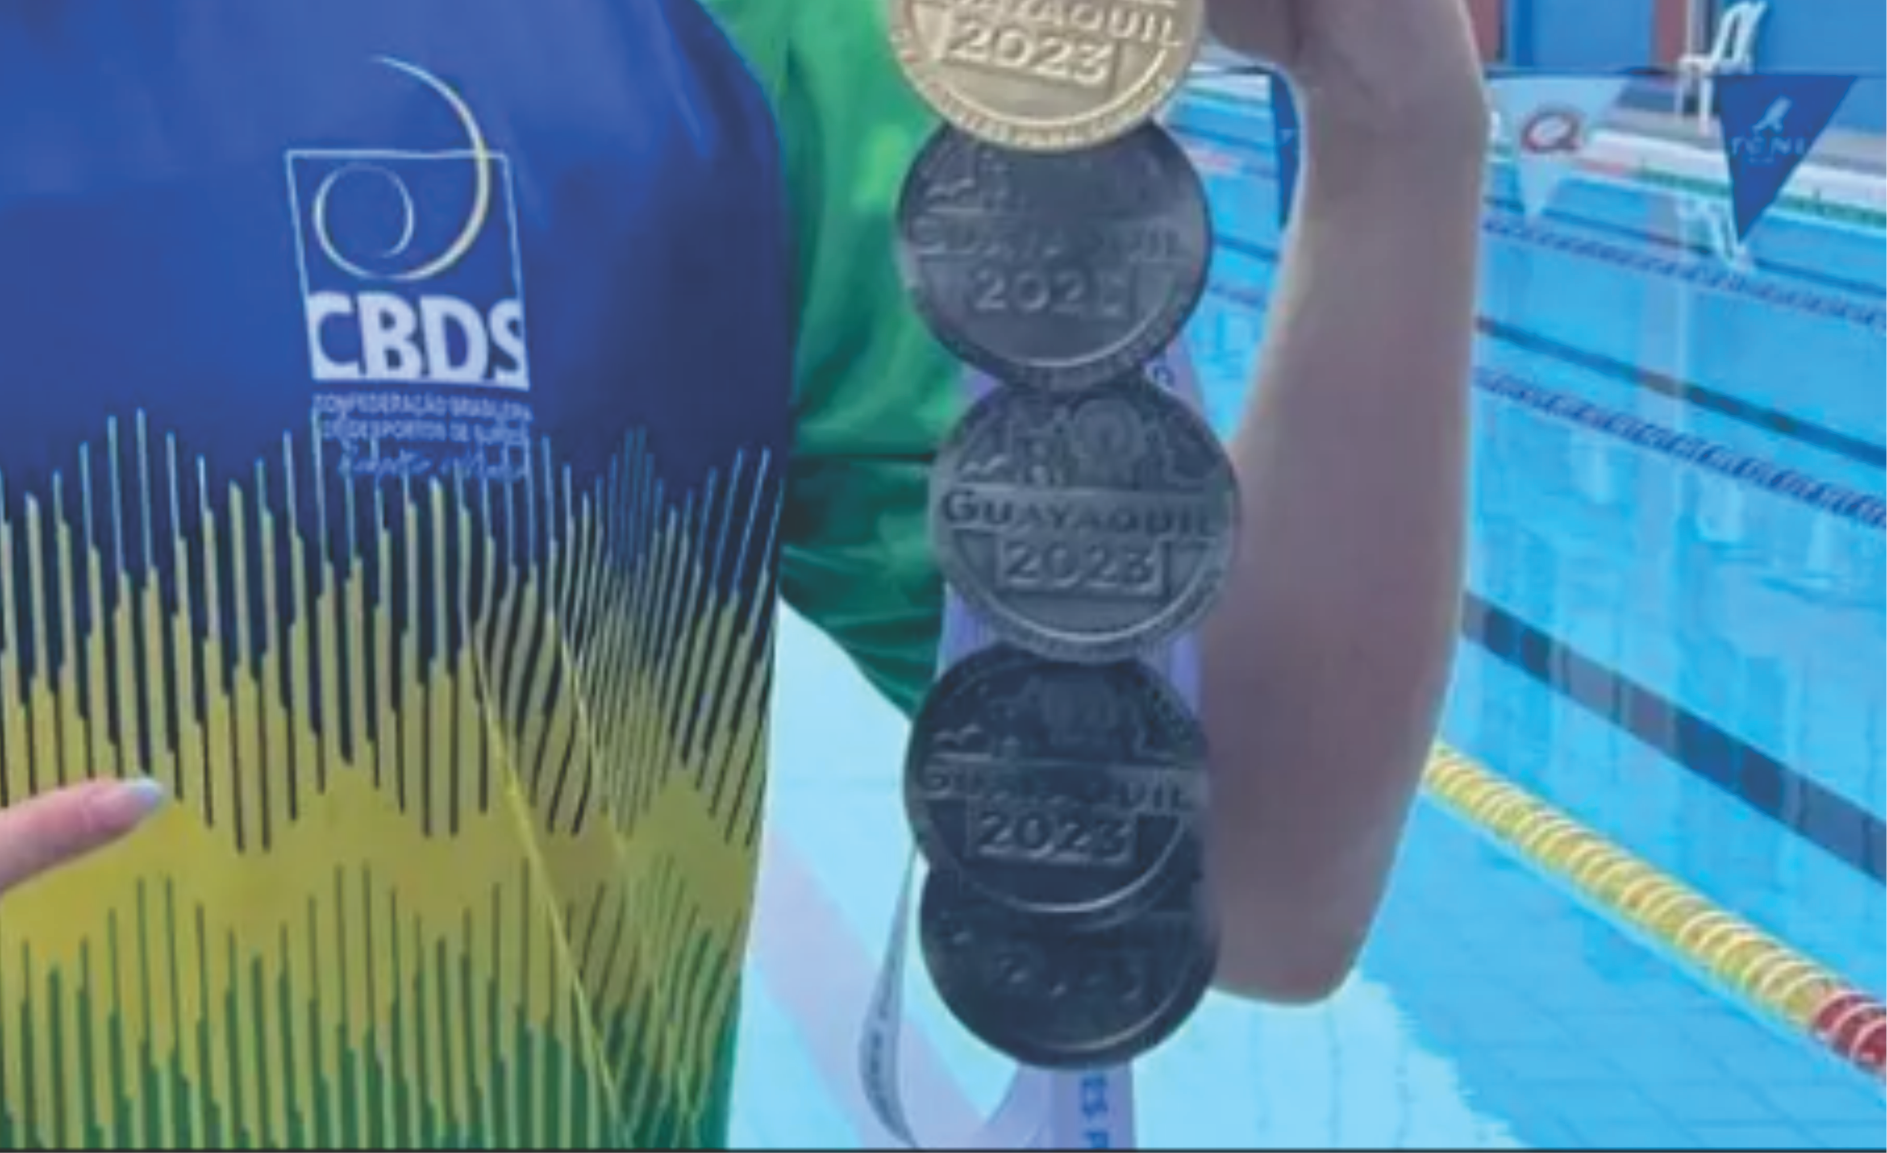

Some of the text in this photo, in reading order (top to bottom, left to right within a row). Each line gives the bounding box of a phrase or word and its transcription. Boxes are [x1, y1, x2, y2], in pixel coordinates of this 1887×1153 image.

[948, 20, 1111, 88] 2023
[307, 290, 529, 391] CBDS
[943, 490, 1217, 539] GUAYAQUIL
[1004, 541, 1159, 591] 2023
[977, 810, 1133, 863] 2023
